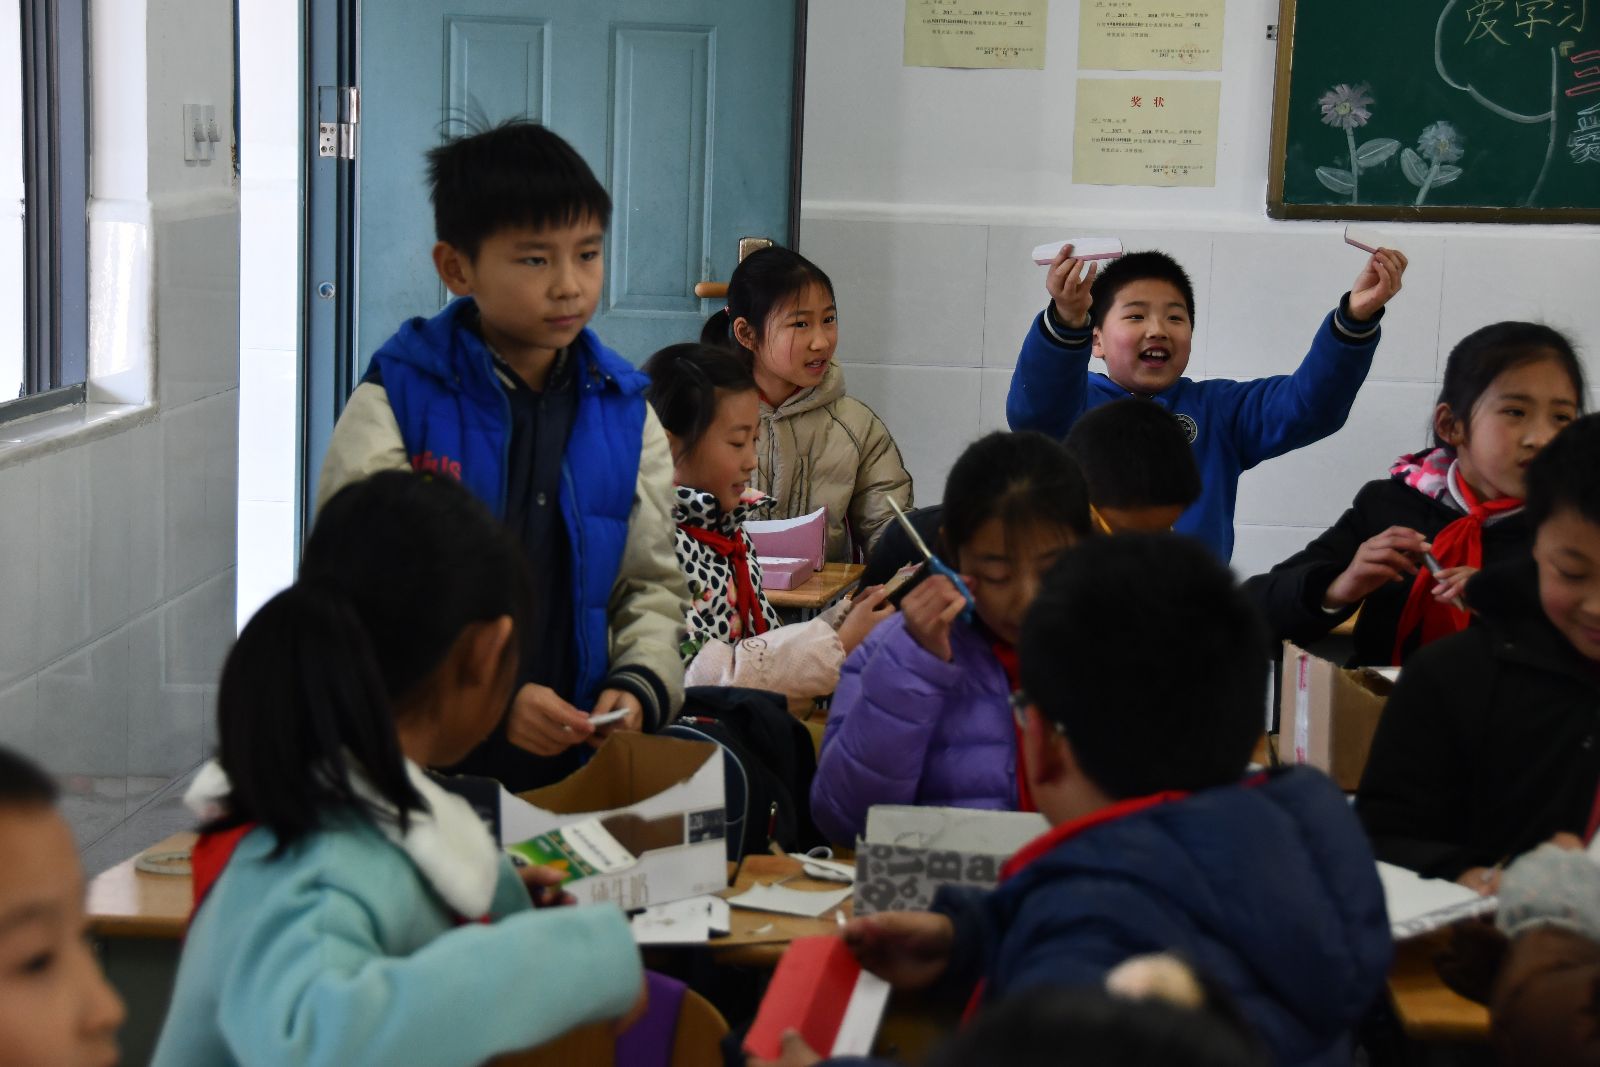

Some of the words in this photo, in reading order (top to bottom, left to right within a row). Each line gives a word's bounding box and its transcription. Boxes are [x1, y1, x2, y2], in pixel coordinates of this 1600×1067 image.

[1464, 0, 1586, 45] 爱学习
[1130, 96, 1165, 108] 奖状
